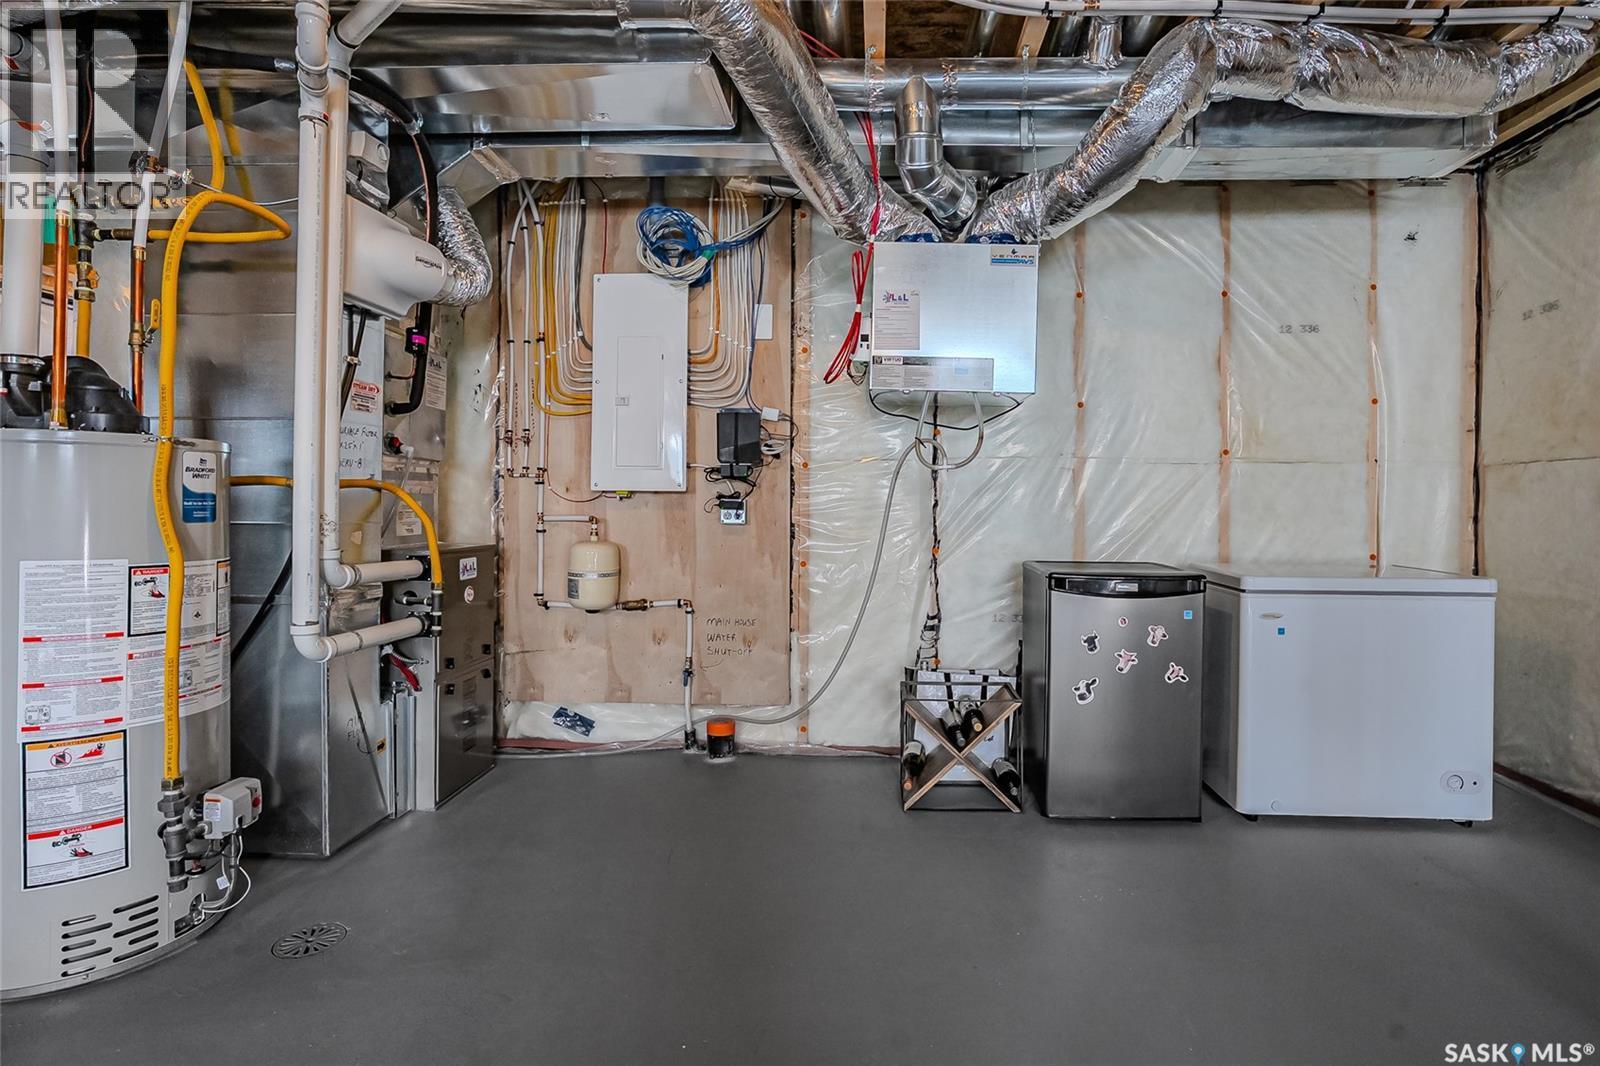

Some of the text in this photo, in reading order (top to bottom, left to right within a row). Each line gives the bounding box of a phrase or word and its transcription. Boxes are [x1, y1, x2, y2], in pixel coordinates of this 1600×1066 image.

[1279, 324, 1293, 334] 12
[706, 618, 757, 626] MAIN HOUSE
[706, 633, 737, 642] WATER
